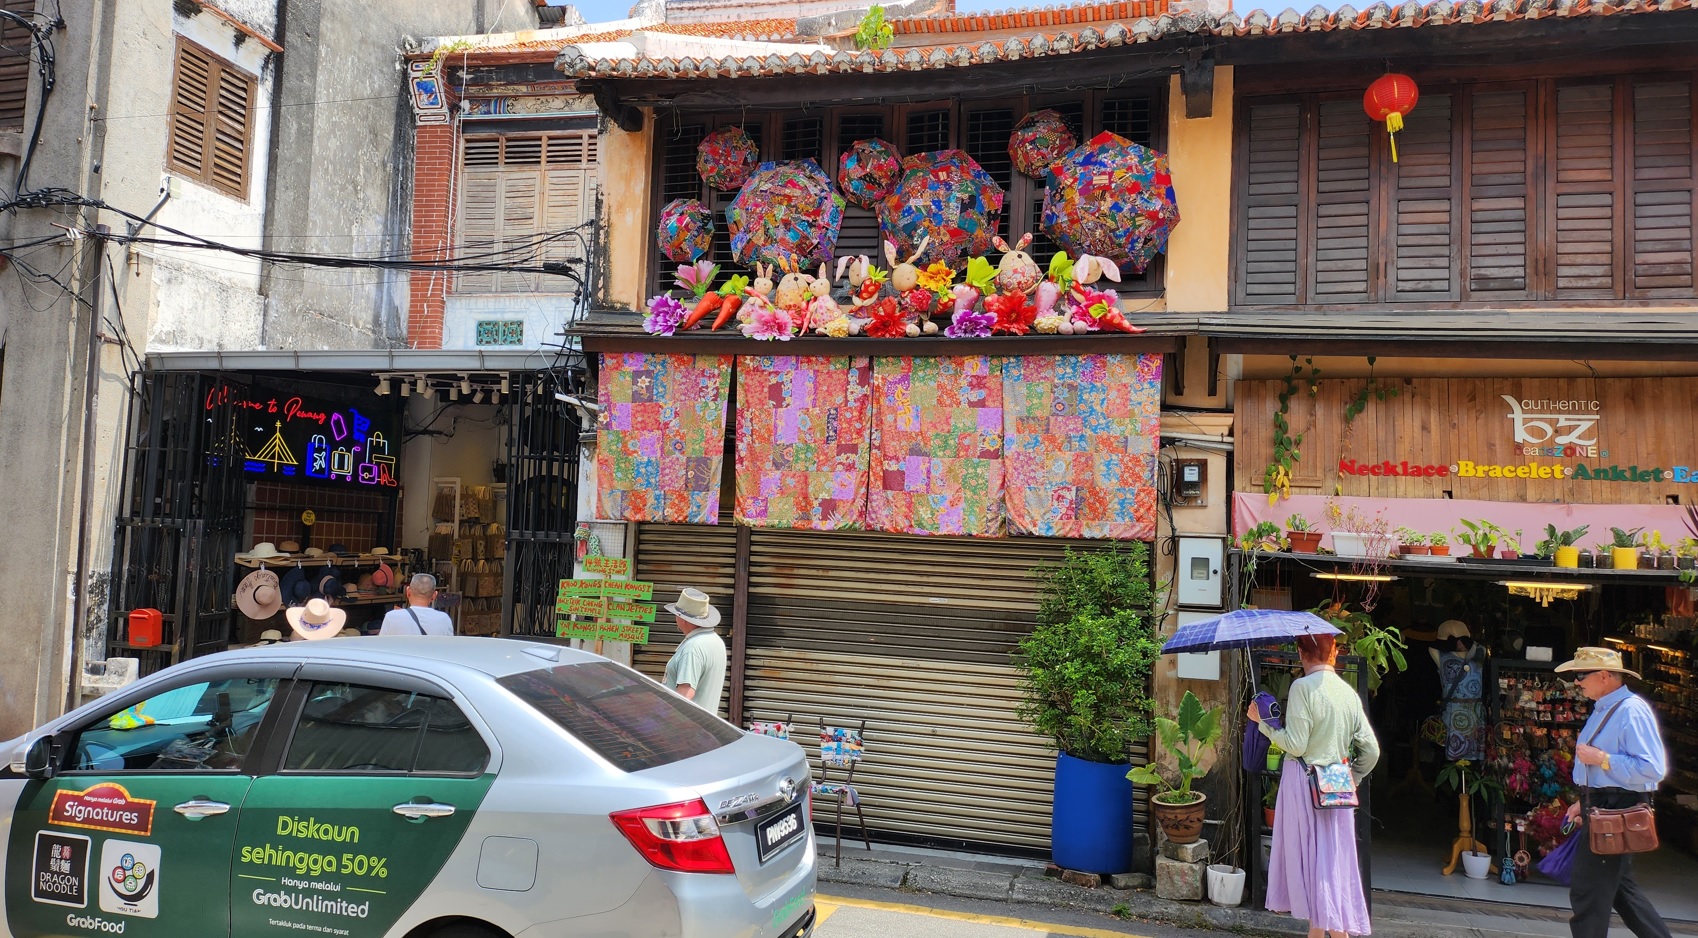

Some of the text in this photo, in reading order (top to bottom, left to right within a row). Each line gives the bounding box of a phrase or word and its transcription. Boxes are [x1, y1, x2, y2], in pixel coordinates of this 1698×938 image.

[267, 399, 278, 413] to
[284, 397, 327, 425] Penang
[1339, 459, 1450, 478] Necklace
[1457, 460, 1565, 479] Bracelet
[1571, 462, 1665, 483] Anklet
[578, 580, 602, 589] KONGS
[604, 581, 652, 592] CHEAH KONGSI
[607, 602, 653, 614] CLAN JETTIES
[622, 625, 644, 635] STREET
[113, 797, 125, 805] Grab
[64, 801, 138, 824] Signatures
[276, 815, 359, 843] Diskaun
[241, 843, 388, 878] sehingga 50%
[40, 872, 79, 886] DRAGON
[281, 877, 341, 892] Hanya melalui
[40, 881, 78, 896] NOODLE
[252, 889, 369, 918] GrabUnlimited
[66, 914, 125, 934] GrabFood
[269, 918, 292, 928] Tertakluk
[306, 924, 322, 932] terma
[333, 928, 350, 936] syarat
